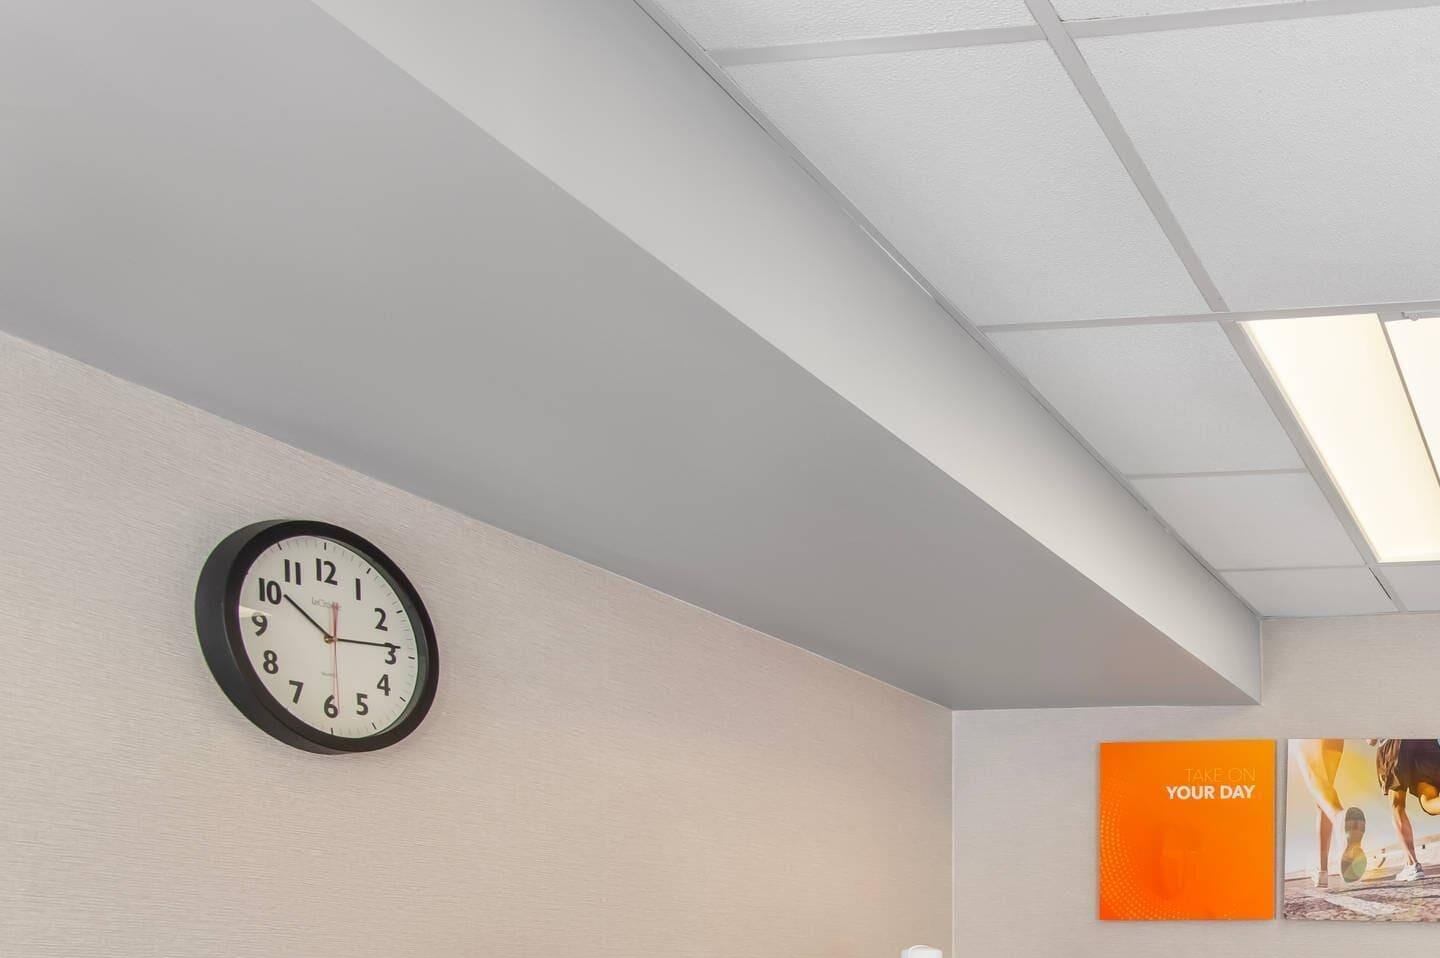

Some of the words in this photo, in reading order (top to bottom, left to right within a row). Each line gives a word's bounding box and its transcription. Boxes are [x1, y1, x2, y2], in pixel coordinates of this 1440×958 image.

[284, 559, 302, 585] 11
[316, 558, 338, 585] 12
[259, 577, 282, 605] 10
[355, 577, 361, 600] 1
[251, 612, 268, 636] 9
[374, 607, 388, 631] 2
[263, 650, 279, 674] 8
[383, 642, 397, 665] 3
[288, 680, 304, 704] 7
[377, 674, 391, 696] 4
[323, 694, 338, 719] 6
[356, 693, 369, 716] 5
[1183, 767, 1225, 782] TAKE
[1228, 767, 1256, 782] ON
[1166, 785, 1215, 800] YOUR
[1220, 784, 1256, 799] DAY
